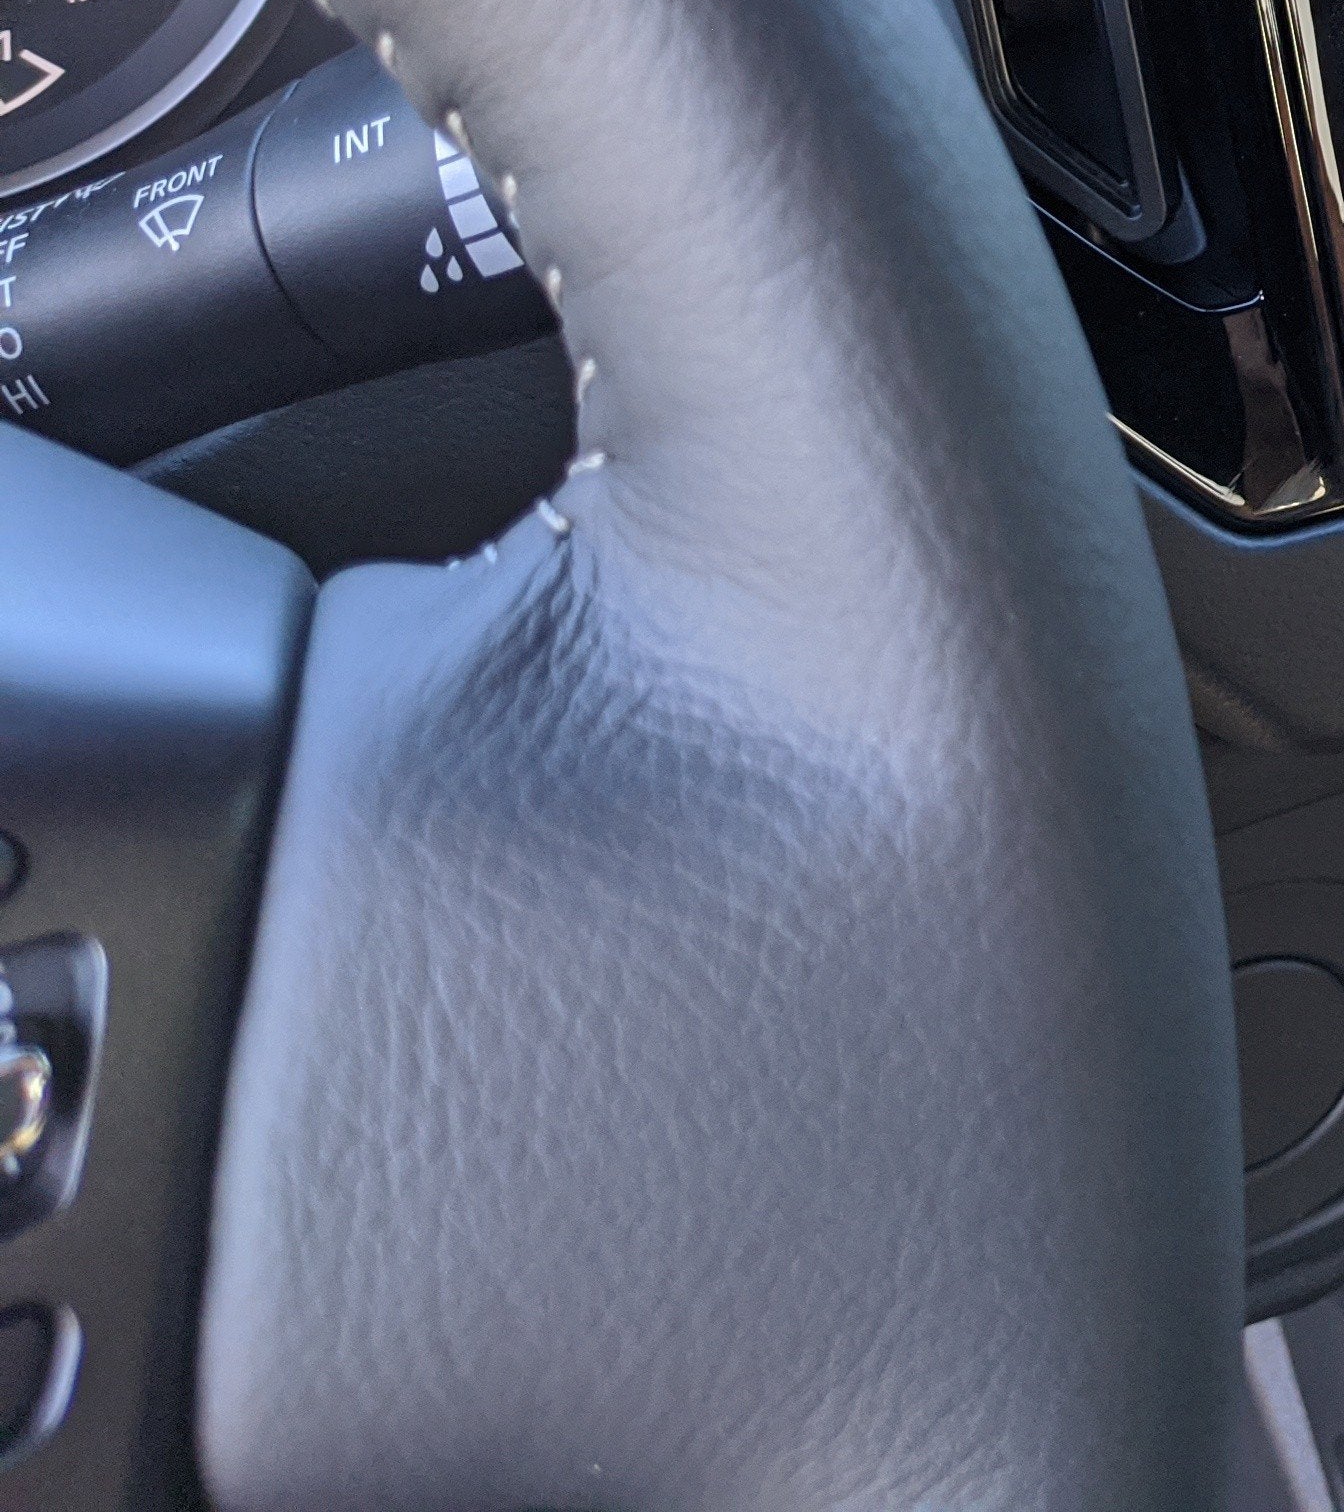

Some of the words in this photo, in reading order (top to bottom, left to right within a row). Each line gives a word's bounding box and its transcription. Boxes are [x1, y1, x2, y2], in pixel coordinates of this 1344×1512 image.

[332, 115, 392, 164] INT
[133, 154, 224, 209] FRONT
[1, 374, 51, 415] HI
